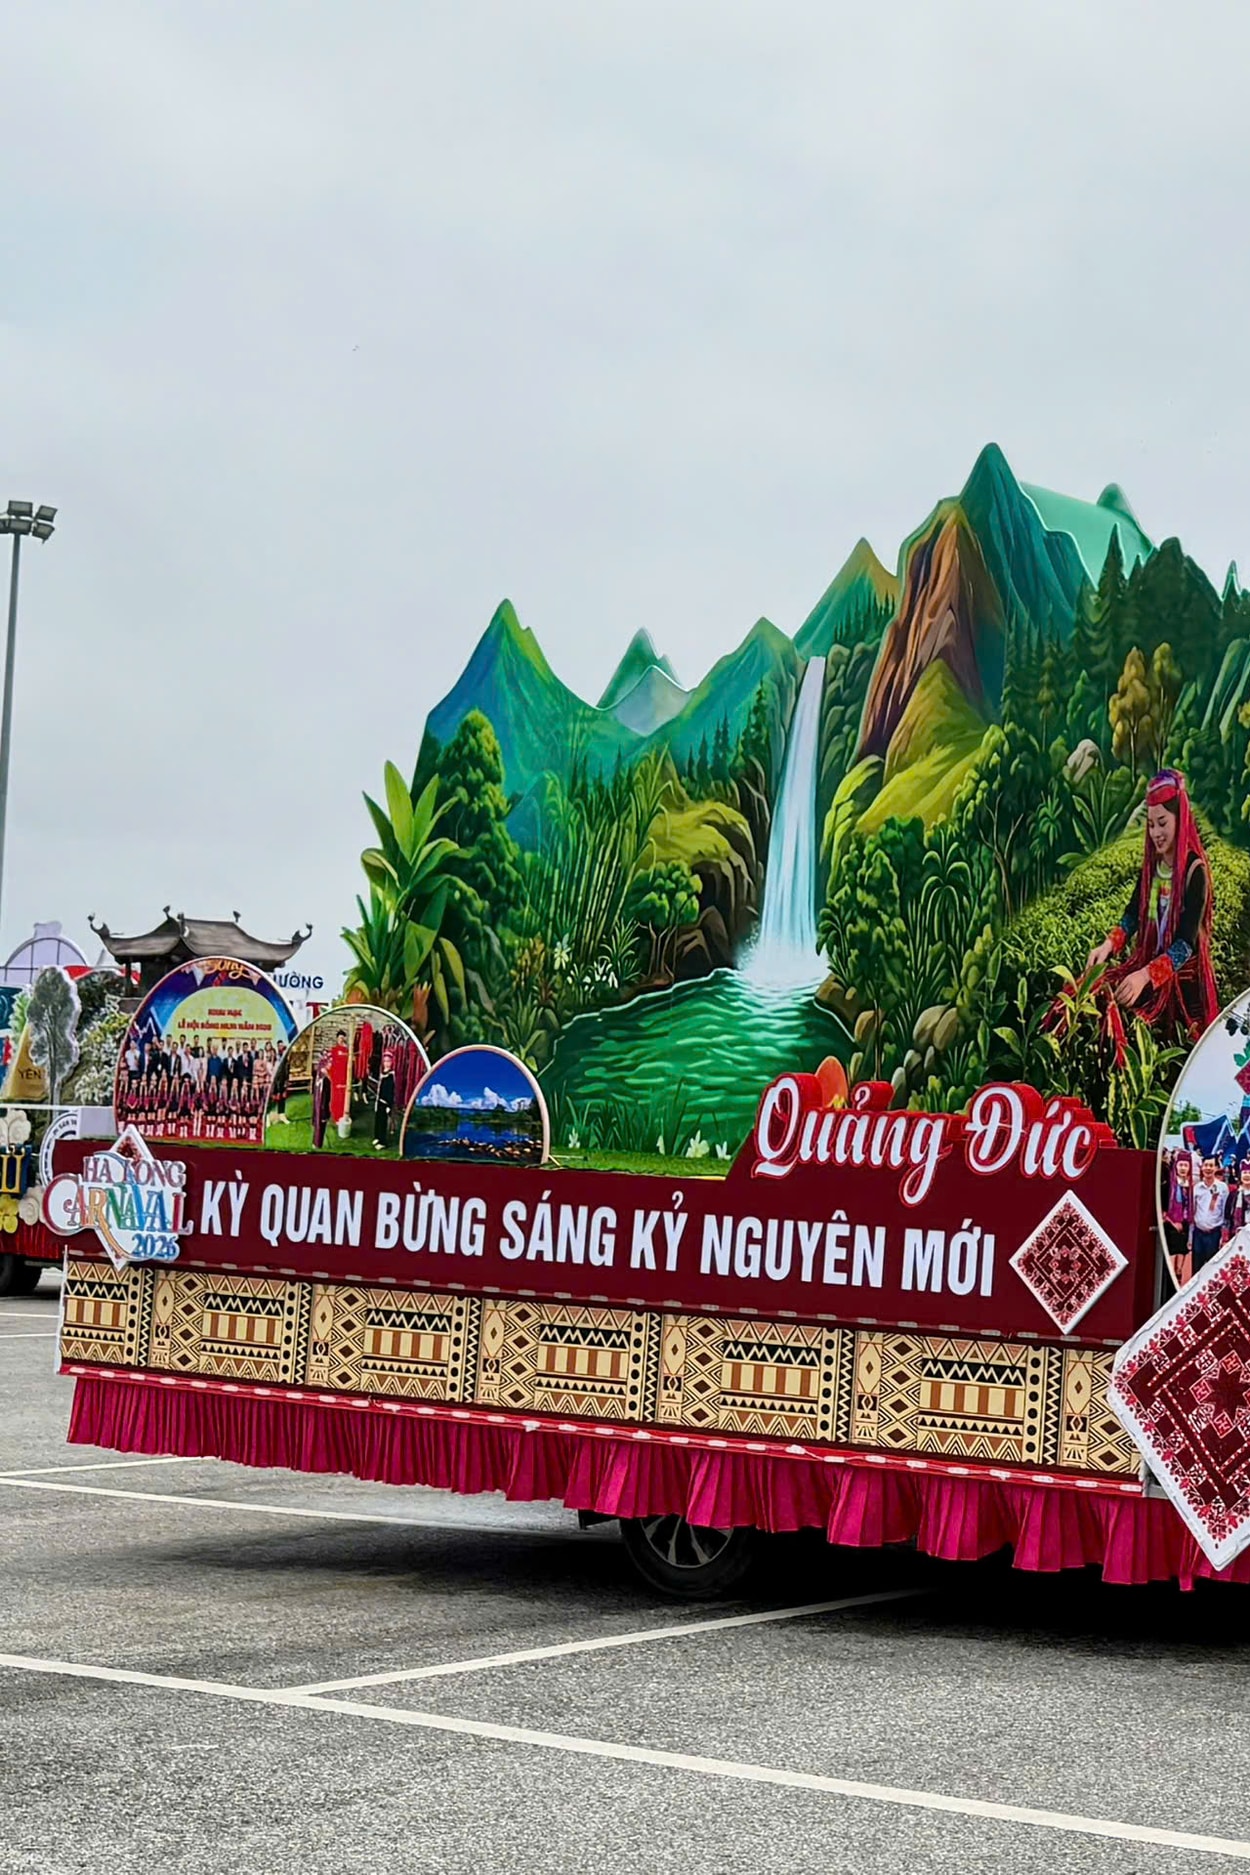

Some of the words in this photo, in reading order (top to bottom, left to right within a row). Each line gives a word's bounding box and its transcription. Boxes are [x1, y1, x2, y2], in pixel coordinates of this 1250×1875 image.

[83, 1156, 113, 1183] HA
[123, 1158, 186, 1188] LONG
[752, 1077, 952, 1206] Quảng
[965, 1084, 1097, 1179] Đức
[43, 1173, 194, 1237] CARNAVAL
[200, 1170, 250, 1238] KỲ
[260, 1183, 364, 1247] QUAN
[375, 1181, 488, 1257] BỪNG
[500, 1189, 617, 1268] SÁNG
[629, 1190, 688, 1273] KỶ
[700, 1209, 886, 1288] NGUYÊN
[900, 1218, 995, 1297] MỚI
[131, 1233, 178, 1258] 2026
